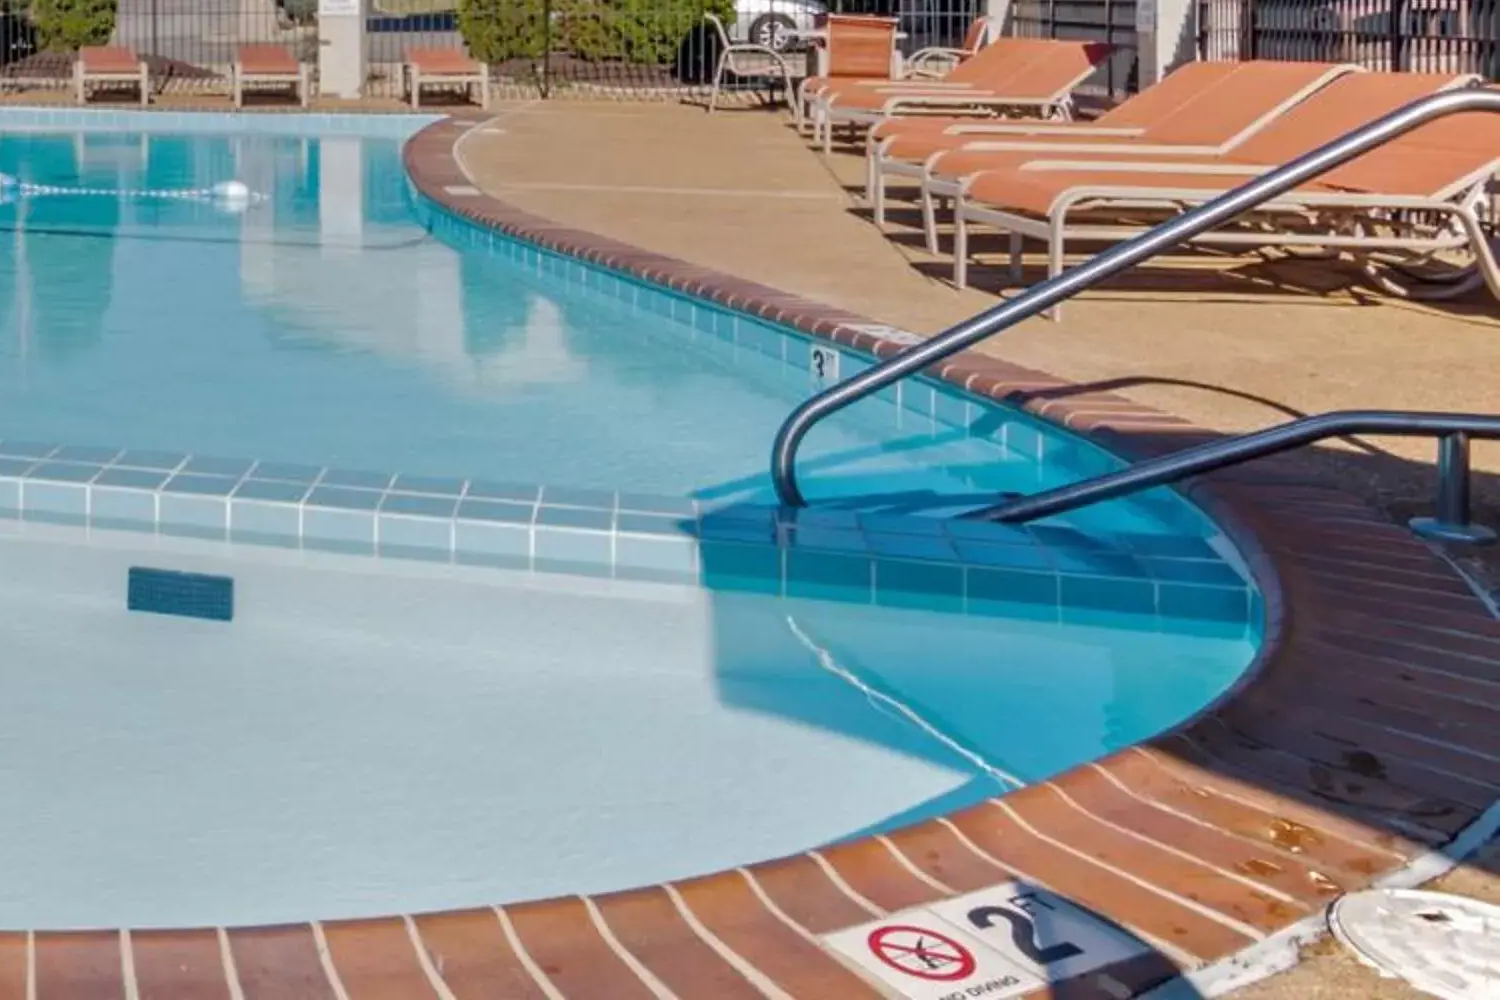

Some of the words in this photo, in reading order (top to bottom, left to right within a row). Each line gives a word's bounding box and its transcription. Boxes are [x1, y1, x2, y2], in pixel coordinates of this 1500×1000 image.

[1007, 891, 1057, 917] FT
[967, 905, 1085, 965] 2
[966, 975, 1019, 996] DIVING
